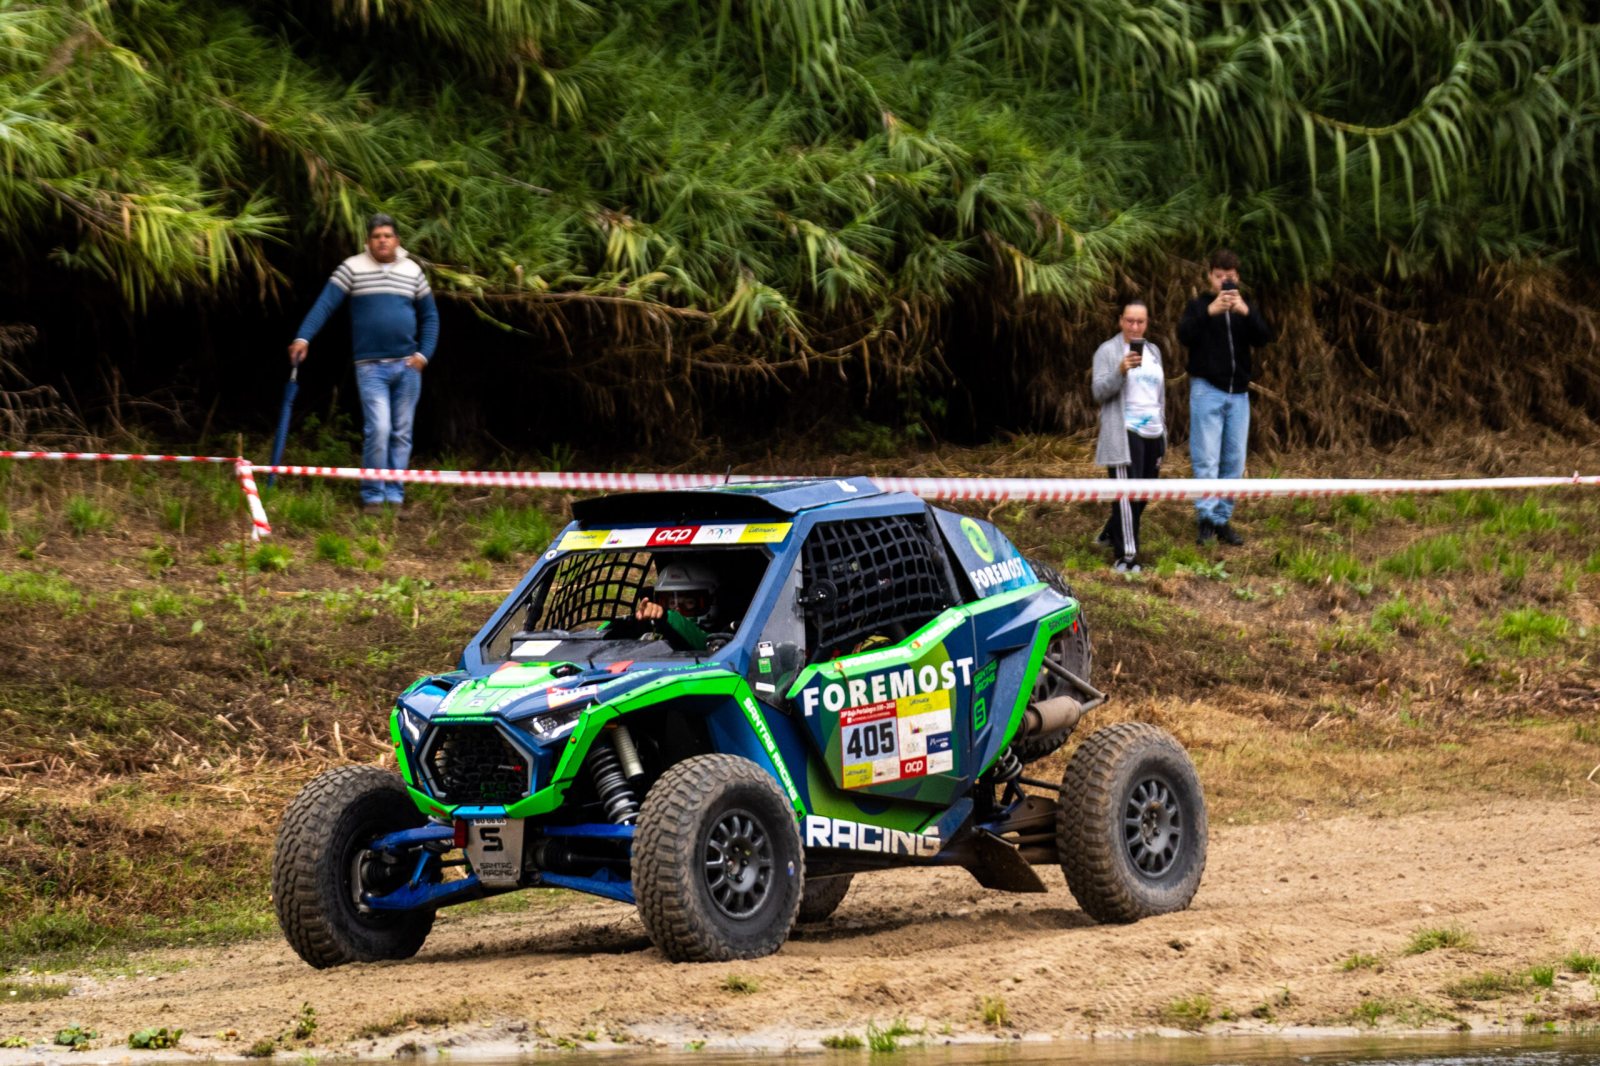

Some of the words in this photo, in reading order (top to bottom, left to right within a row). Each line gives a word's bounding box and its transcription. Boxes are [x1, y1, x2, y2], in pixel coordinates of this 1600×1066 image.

[655, 528, 692, 542] acp
[970, 557, 1026, 590] FOREMOST
[803, 657, 973, 717] FOREMOST
[847, 721, 895, 759] 405
[806, 814, 941, 857] RACING
